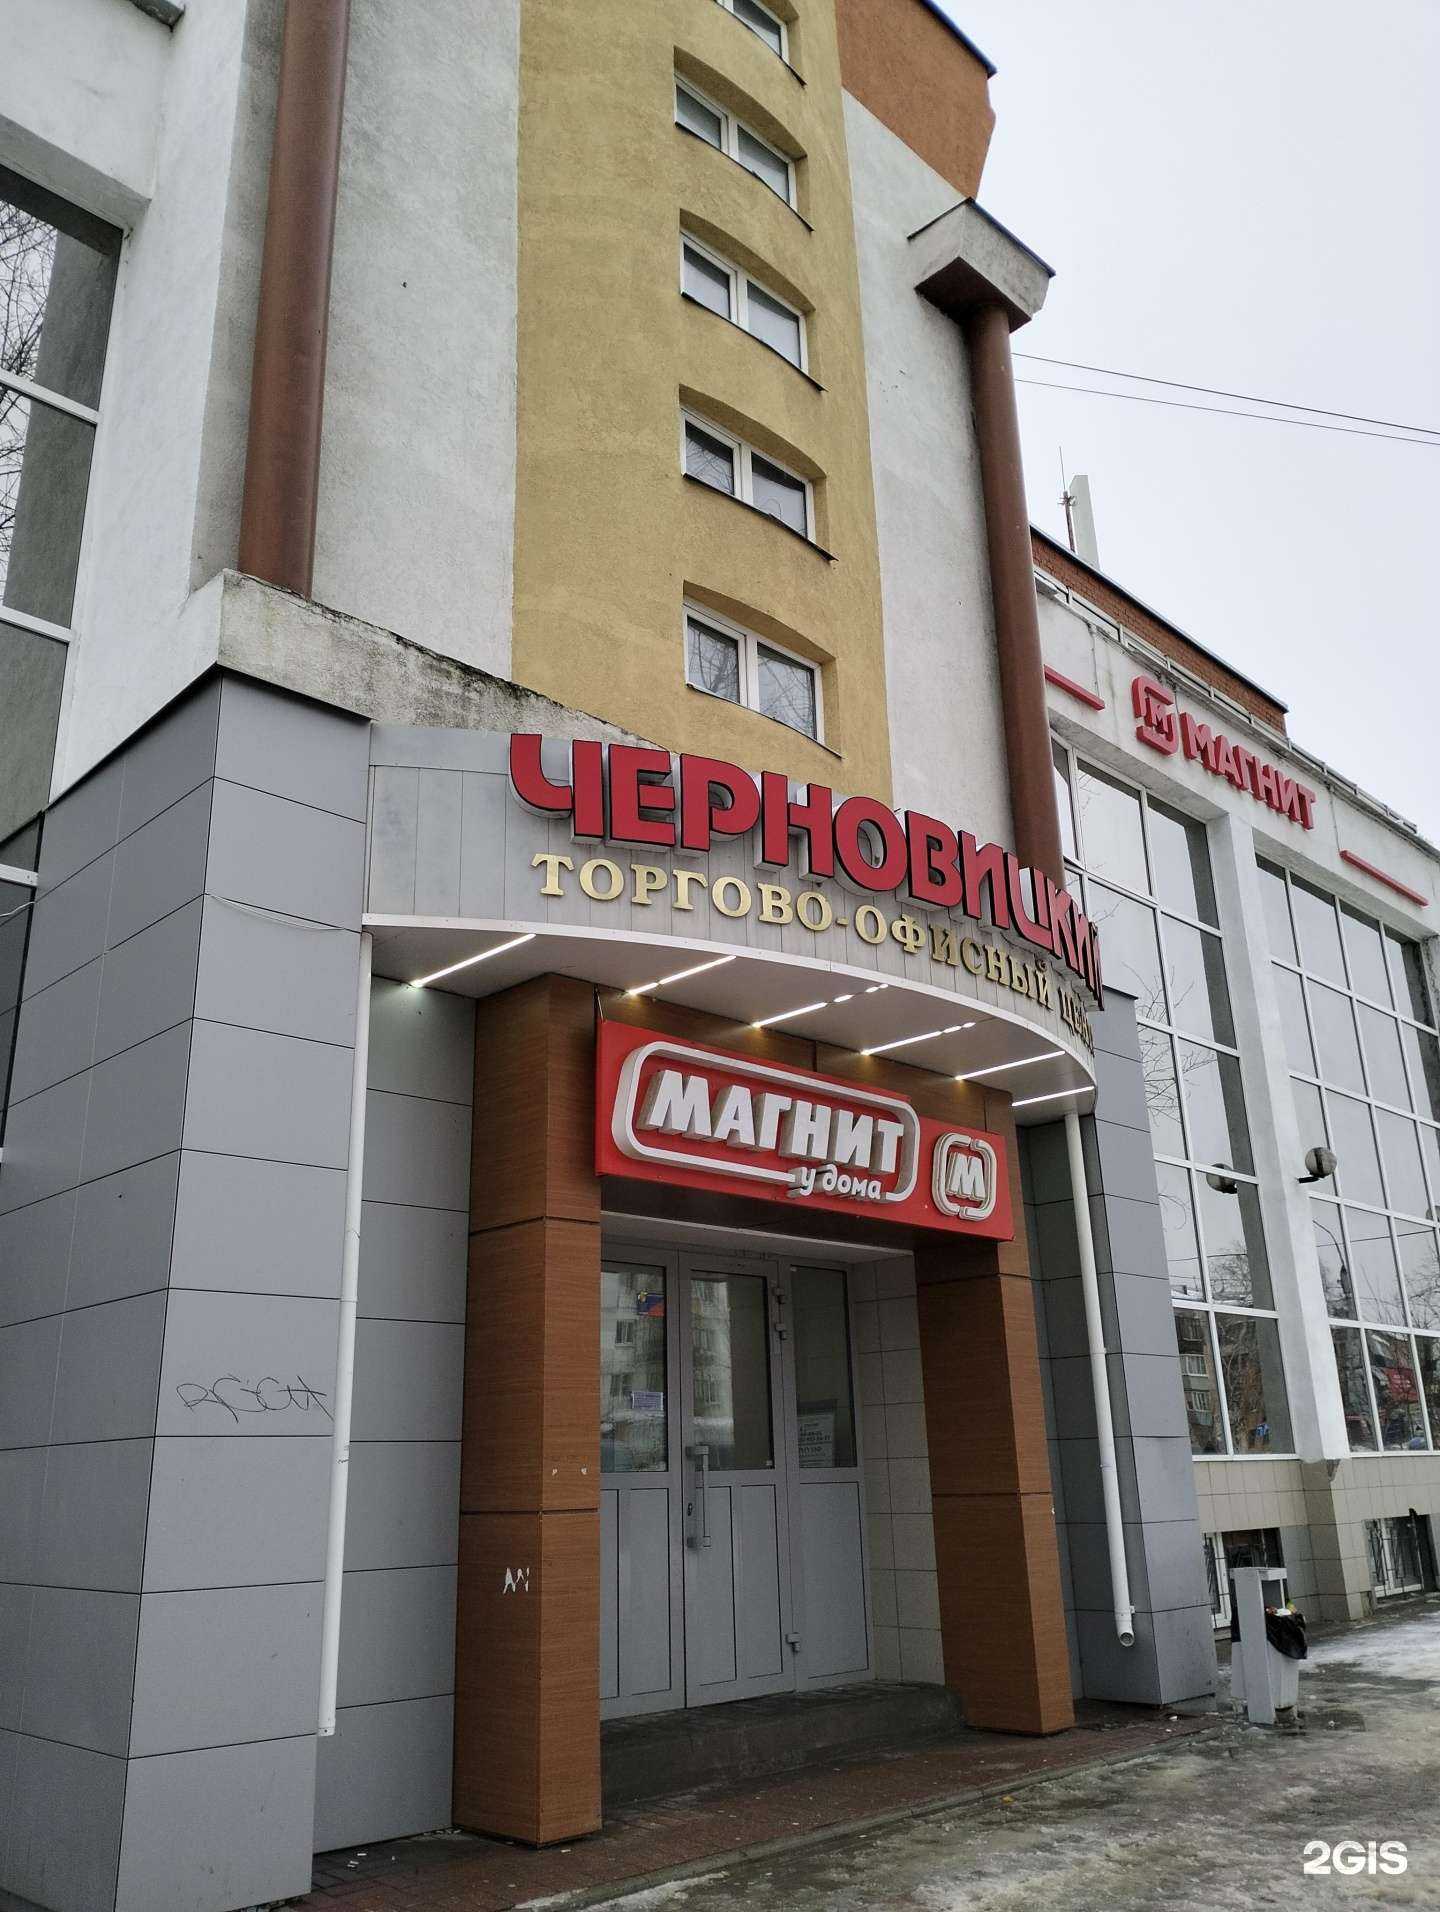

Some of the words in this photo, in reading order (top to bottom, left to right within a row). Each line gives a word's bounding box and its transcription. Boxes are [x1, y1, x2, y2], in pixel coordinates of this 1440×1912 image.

[1179, 711, 1316, 831] МАГНИТ
[530, 853, 1054, 1012] ТОРГОВО-ОФИСНЫЙ
[638, 1069, 905, 1173] МАГНИТ
[796, 1166, 816, 1197] у
[821, 1164, 882, 1200] дома
